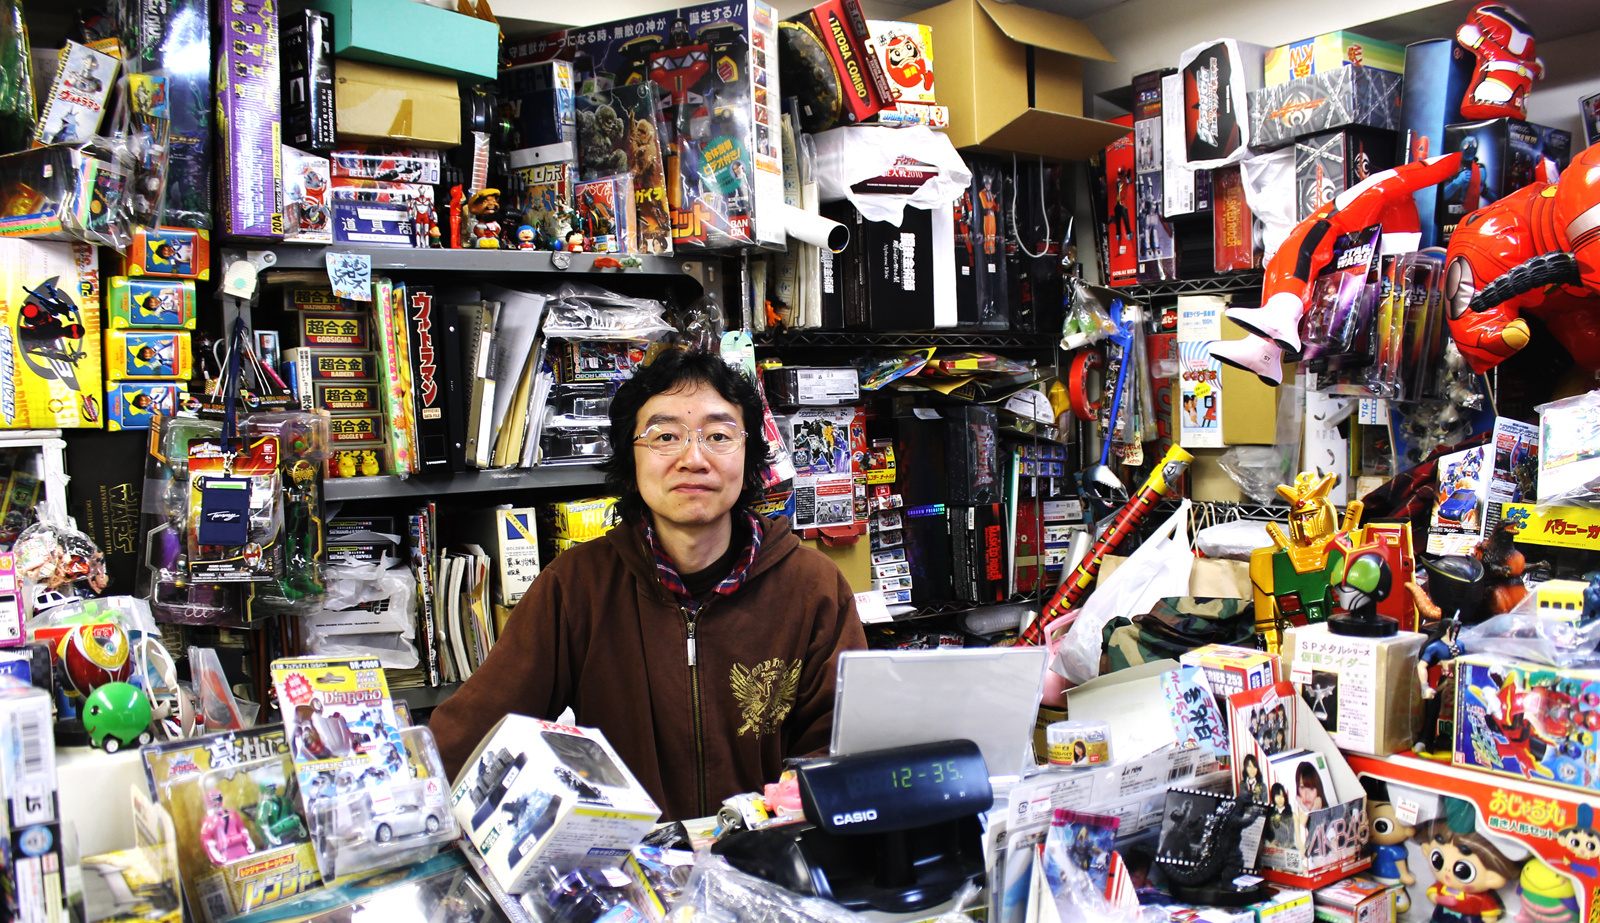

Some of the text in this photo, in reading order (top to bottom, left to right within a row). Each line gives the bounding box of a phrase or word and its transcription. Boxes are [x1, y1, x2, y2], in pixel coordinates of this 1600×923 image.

[831, 19, 868, 98] TATOBA COMBO
[272, 215, 283, 233] 20A
[730, 219, 748, 229] BAN
[1341, 243, 1372, 260] STAR
[1336, 252, 1371, 269] WARS
[307, 319, 357, 336] 超合金
[316, 336, 353, 344] GODSIGMA
[411, 291, 438, 408] ウルトラマン
[320, 357, 362, 372] 超合金
[326, 388, 368, 402] 超合金
[338, 433, 357, 441] GOGGLE
[100, 485, 109, 515] REVENGE
[105, 540, 113, 555] SITH
[109, 484, 135, 554] WARS
[989, 525, 1002, 581] MASKED RIDER
[350, 660, 379, 670] DR-0000
[1226, 672, 1244, 687] 253
[1171, 671, 1191, 724] プラレール
[1489, 789, 1566, 827] おじゃる丸
[833, 809, 878, 826] CASIO
[1306, 811, 1370, 858] AKB48
